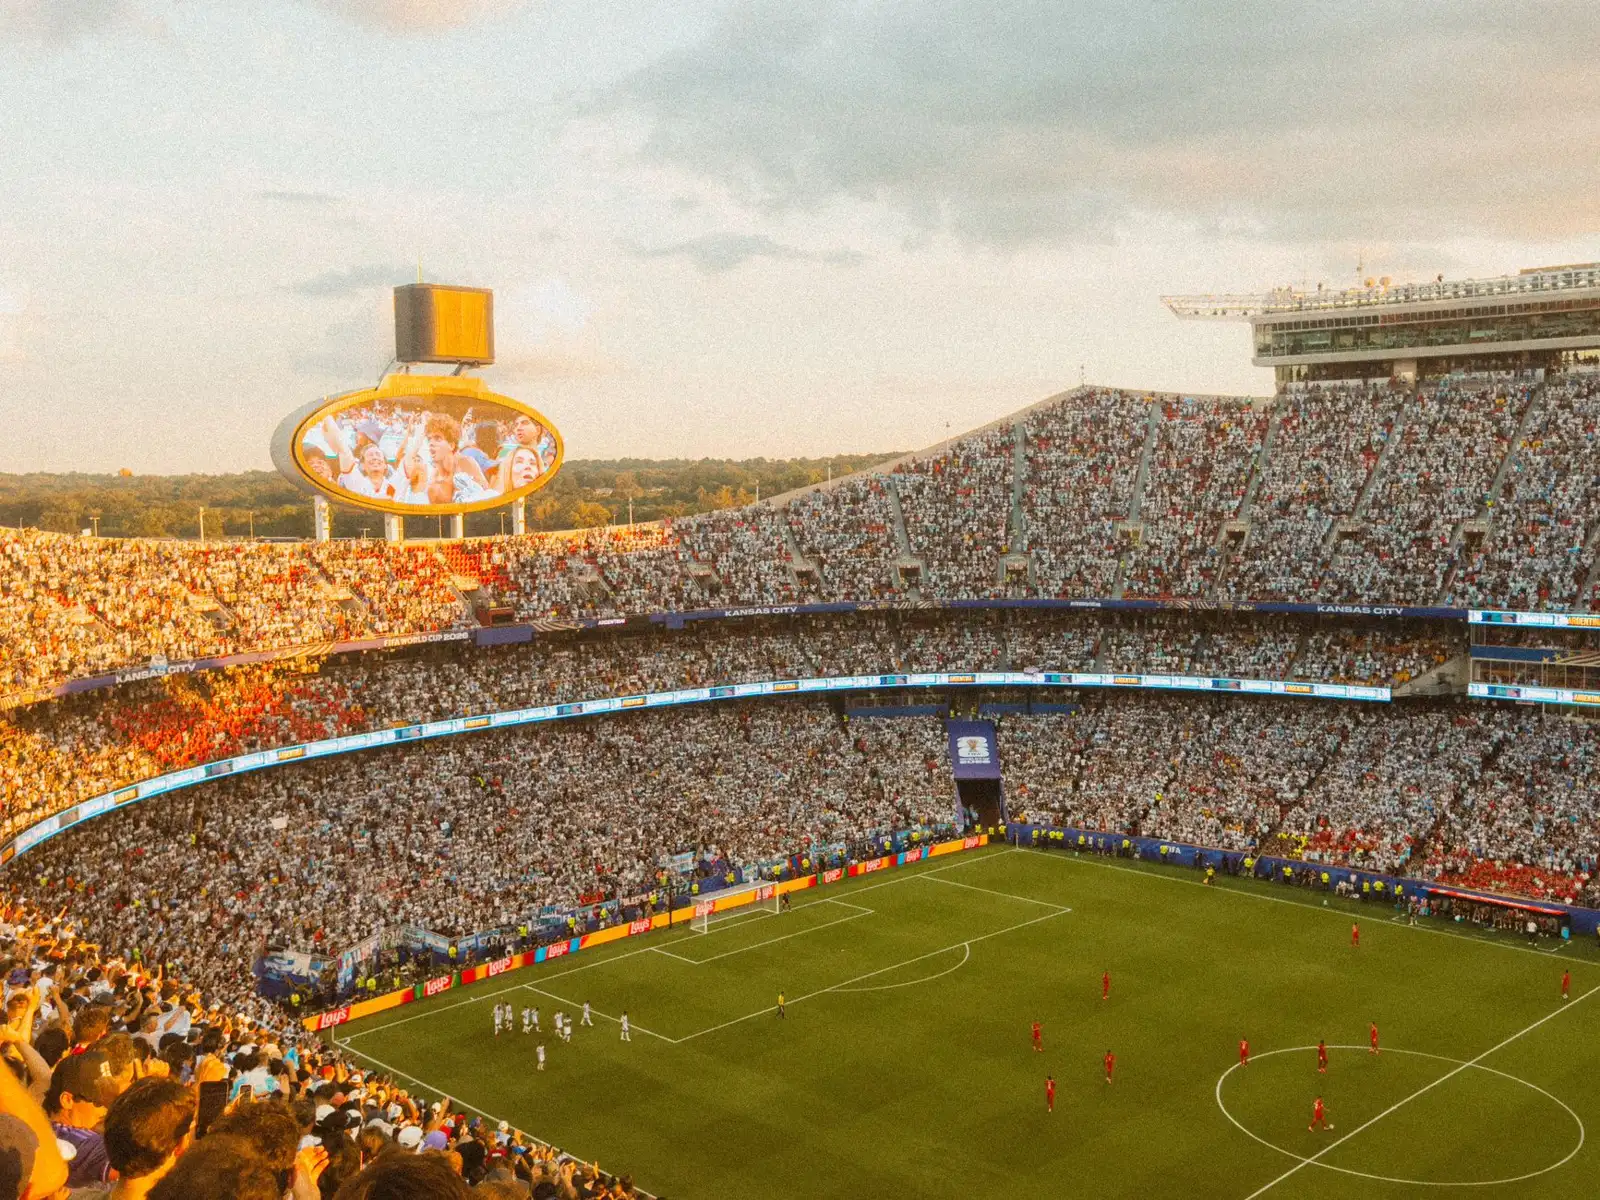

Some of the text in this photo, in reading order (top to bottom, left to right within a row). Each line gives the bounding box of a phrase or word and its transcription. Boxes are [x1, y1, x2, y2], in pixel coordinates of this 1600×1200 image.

[725, 606, 798, 617] KANSAS CITY
[1317, 605, 1371, 614] KANSAS
[115, 662, 196, 684] KANSAS CITY
